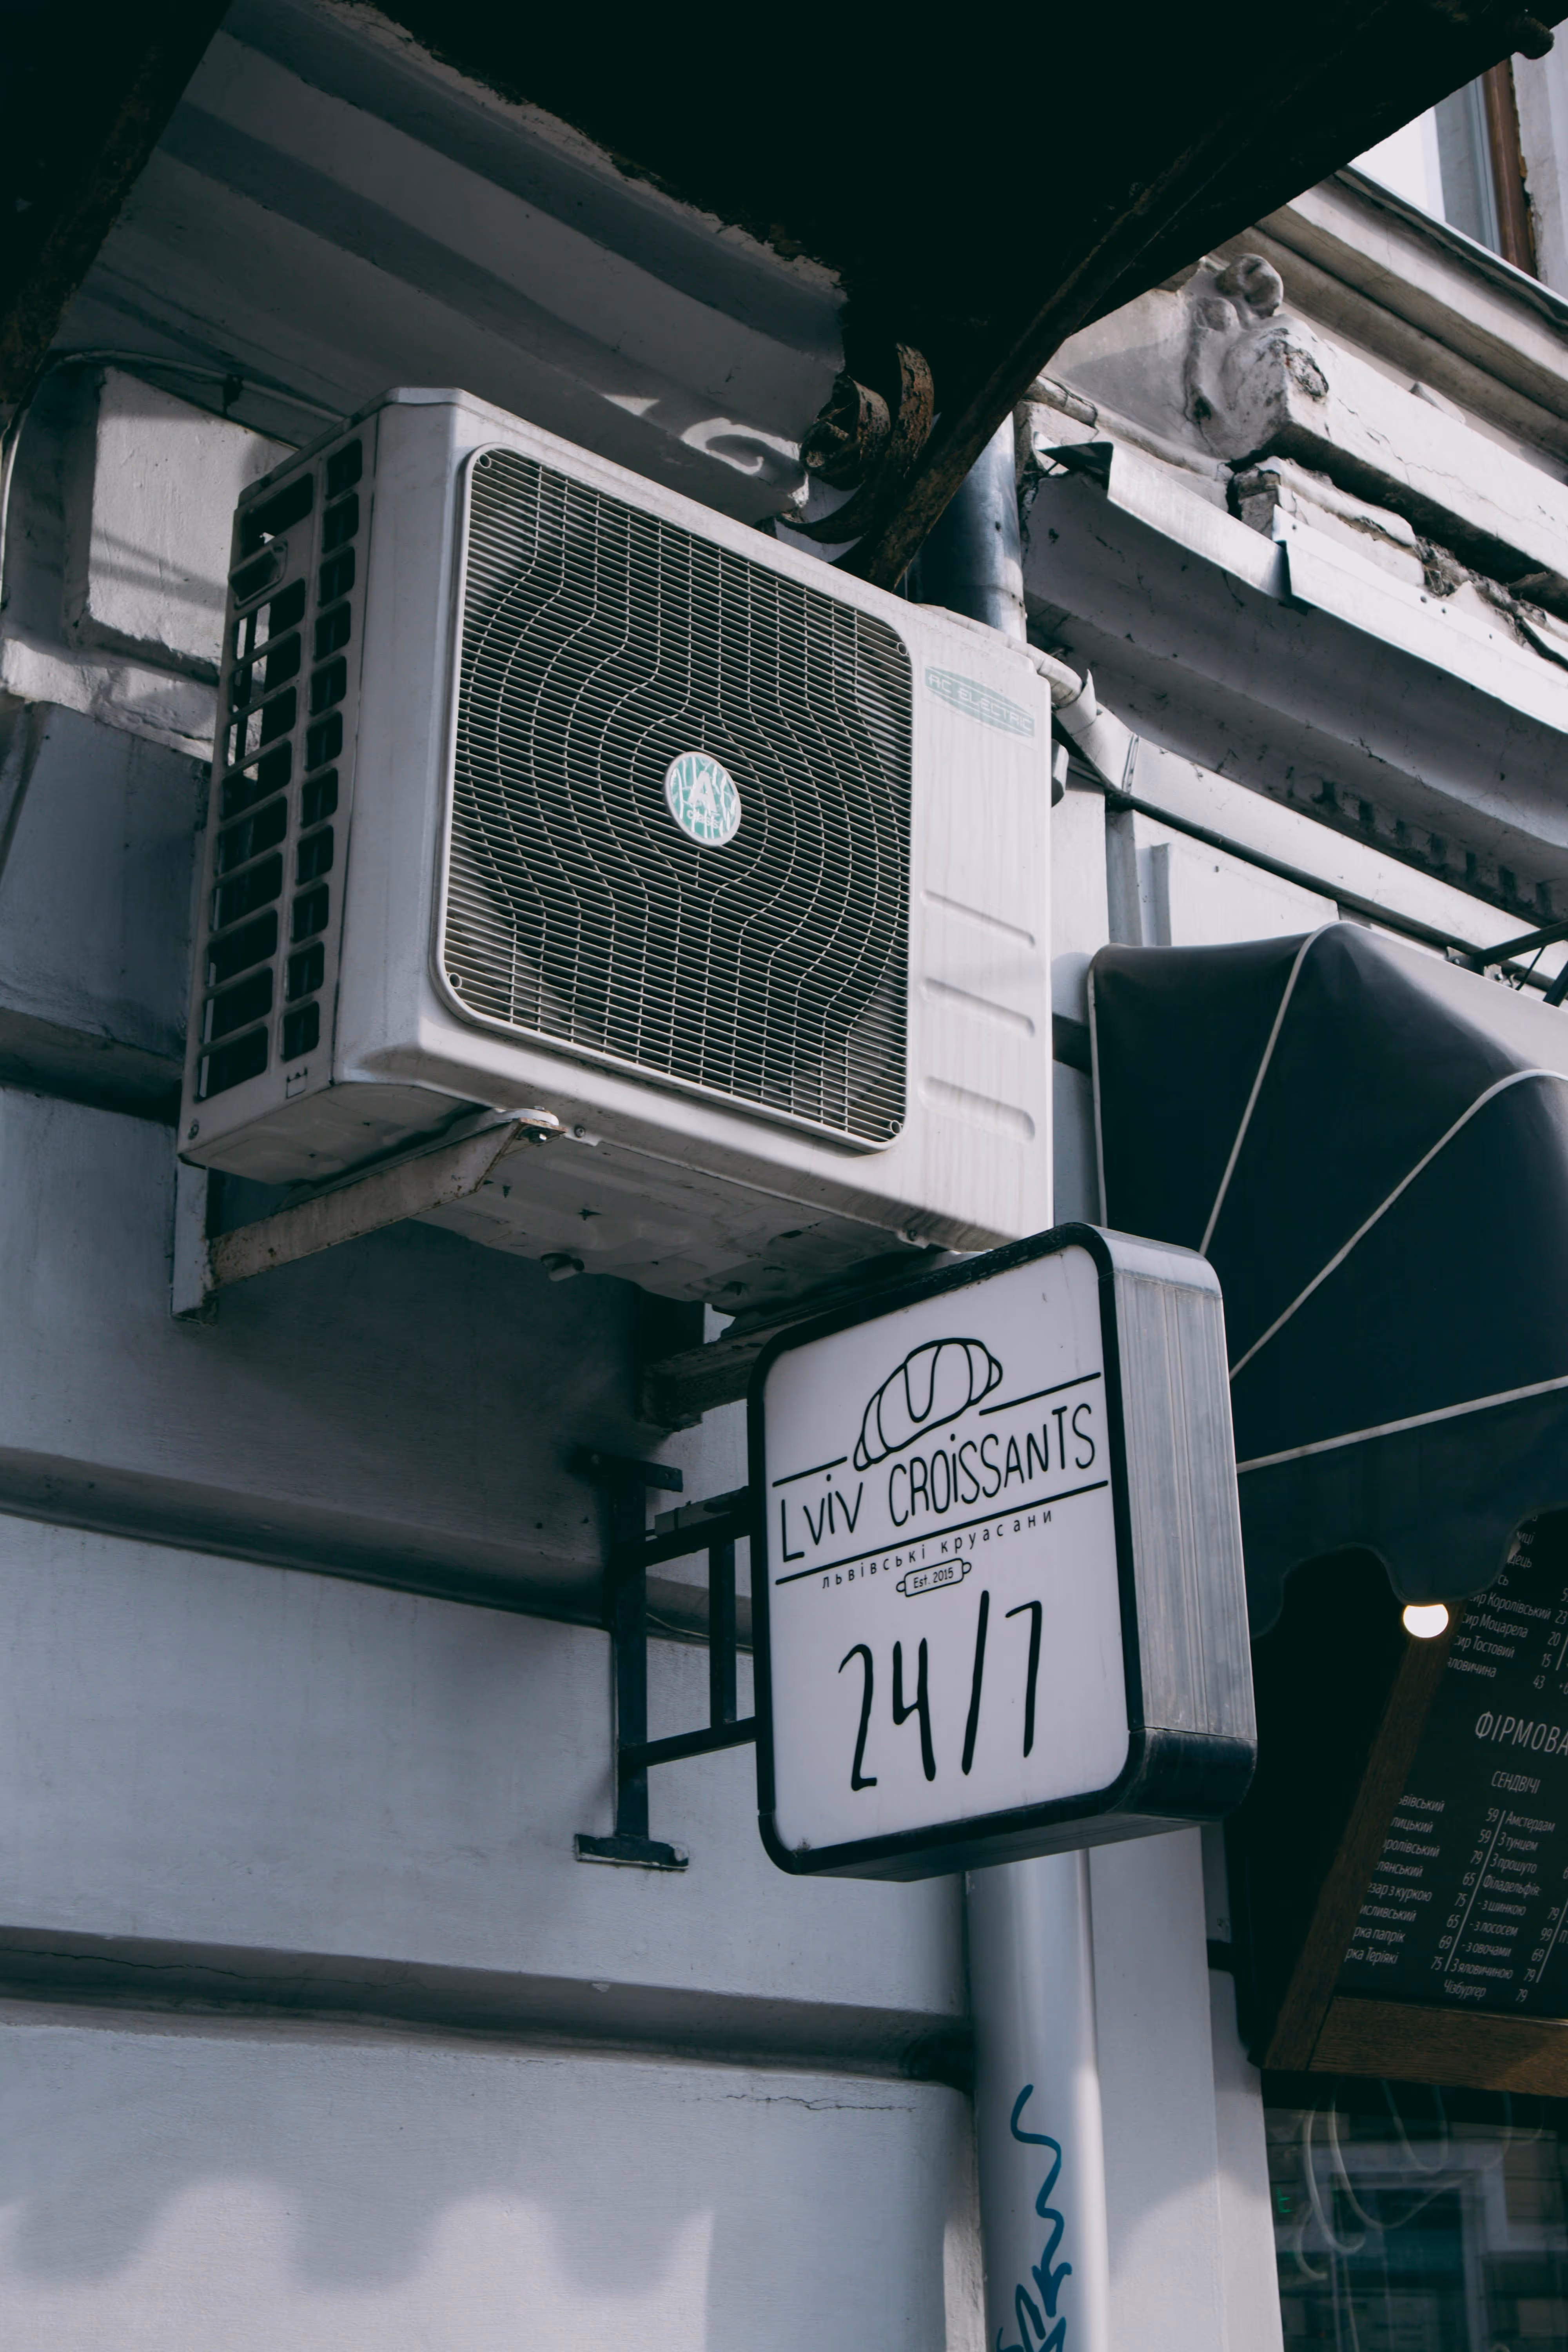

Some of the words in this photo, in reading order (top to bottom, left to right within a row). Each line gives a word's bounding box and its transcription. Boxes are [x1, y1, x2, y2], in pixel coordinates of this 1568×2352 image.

[928, 674, 952, 694] AC
[958, 687, 1032, 731] ELECTRIC
[822, 1544, 926, 1589] львівські
[941, 1510, 1052, 1553] круасани
[913, 1575, 931, 1589] Est.
[933, 1568, 954, 1584] 2015
[1487, 1592, 1552, 1620] Королівський
[1479, 1614, 1528, 1638] Моцарела
[1548, 1632, 1561, 1646] 20
[1473, 1635, 1515, 1658] Тостовий
[1542, 1653, 1552, 1667] 15
[838, 1590, 1042, 1792] 24/7
[1533, 1675, 1546, 1689] 43
[1491, 1771, 1541, 1794] СЕНДВІЧІ
[1485, 1808, 1499, 1822] 59
[1504, 1811, 1555, 1833] Амстердам
[1477, 1829, 1492, 1843] 59
[1506, 1837, 1539, 1851] тунцем
[1470, 1850, 1483, 1865] 79
[1498, 1858, 1537, 1876] прошуто
[1463, 1872, 1476, 1886] 65
[1395, 1887, 1433, 1903] куркою
[1454, 1893, 1468, 1907] 75
[1488, 1901, 1526, 1916] шинкою
[1547, 1907, 1560, 1920] 79
[1446, 1914, 1461, 1928] 65
[1372, 1929, 1406, 1945] папрік
[1438, 1935, 1452, 1949] 69
[1480, 1922, 1519, 1937] лососем
[1540, 1927, 1553, 1941] 99
[1366, 1946, 1399, 1966] Теріякі
[1431, 1956, 1444, 1971] 75
[1472, 1943, 1512, 1957] овочами
[1531, 1948, 1545, 1962] 69
[1457, 1963, 1514, 1979] яловичиною
[1523, 1968, 1536, 1982] 79
[1444, 1979, 1487, 2001] Чізбургер
[1515, 1989, 1528, 2002] 79
